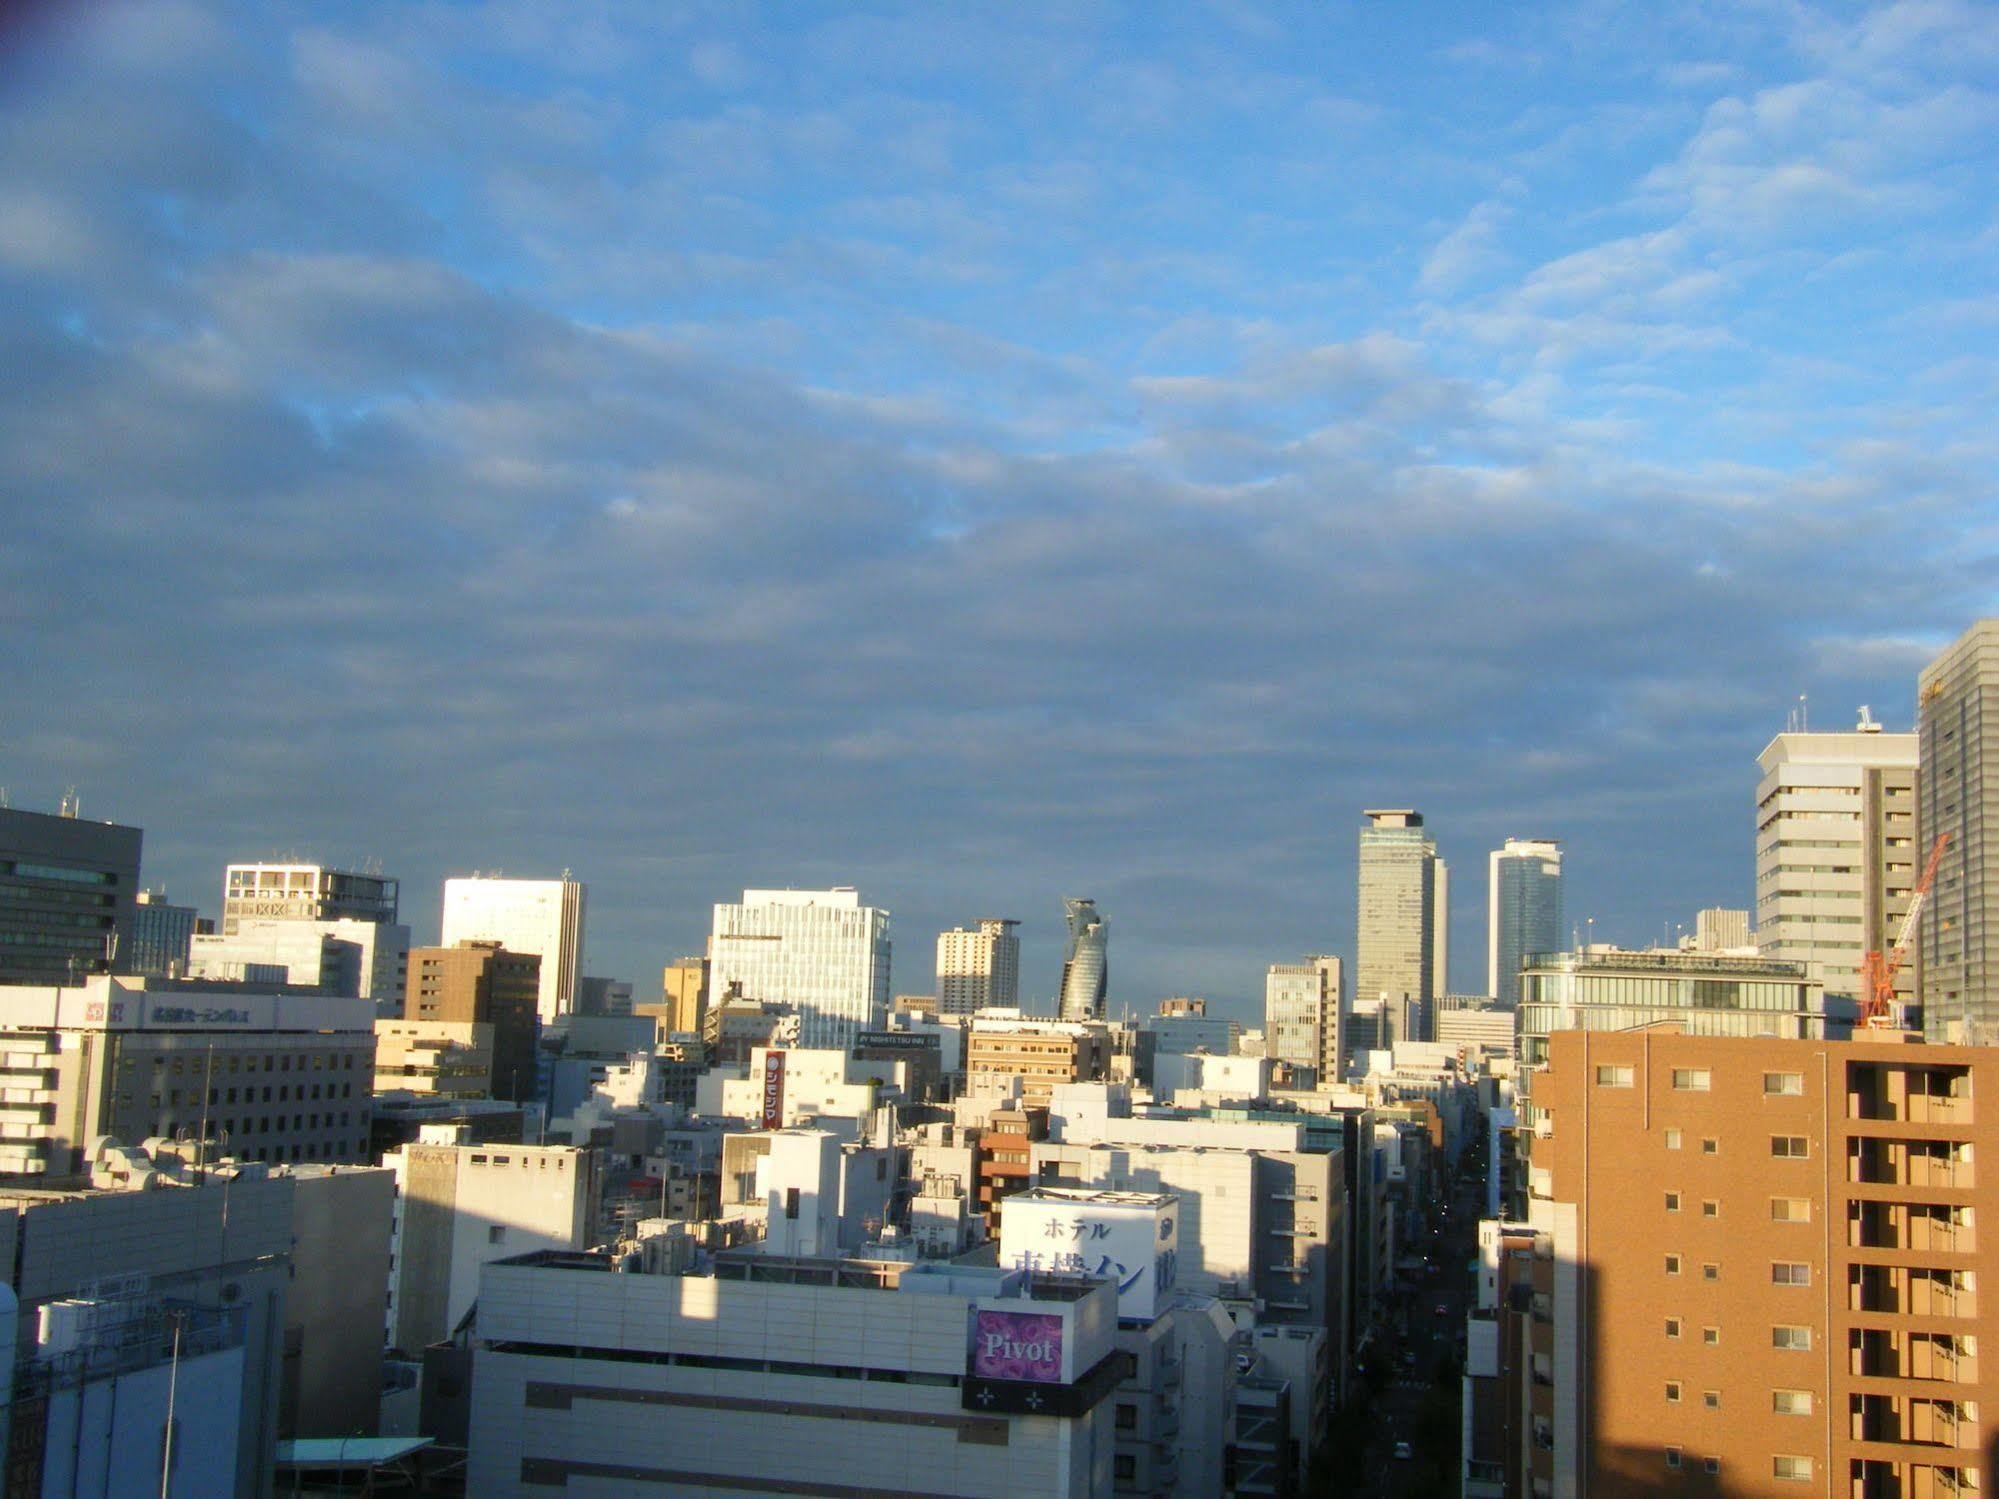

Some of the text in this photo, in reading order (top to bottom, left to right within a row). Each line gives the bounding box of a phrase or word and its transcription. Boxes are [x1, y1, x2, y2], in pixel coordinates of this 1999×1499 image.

[1044, 1217, 1112, 1240] ホテル
[984, 1332, 1054, 1362] Pivot
